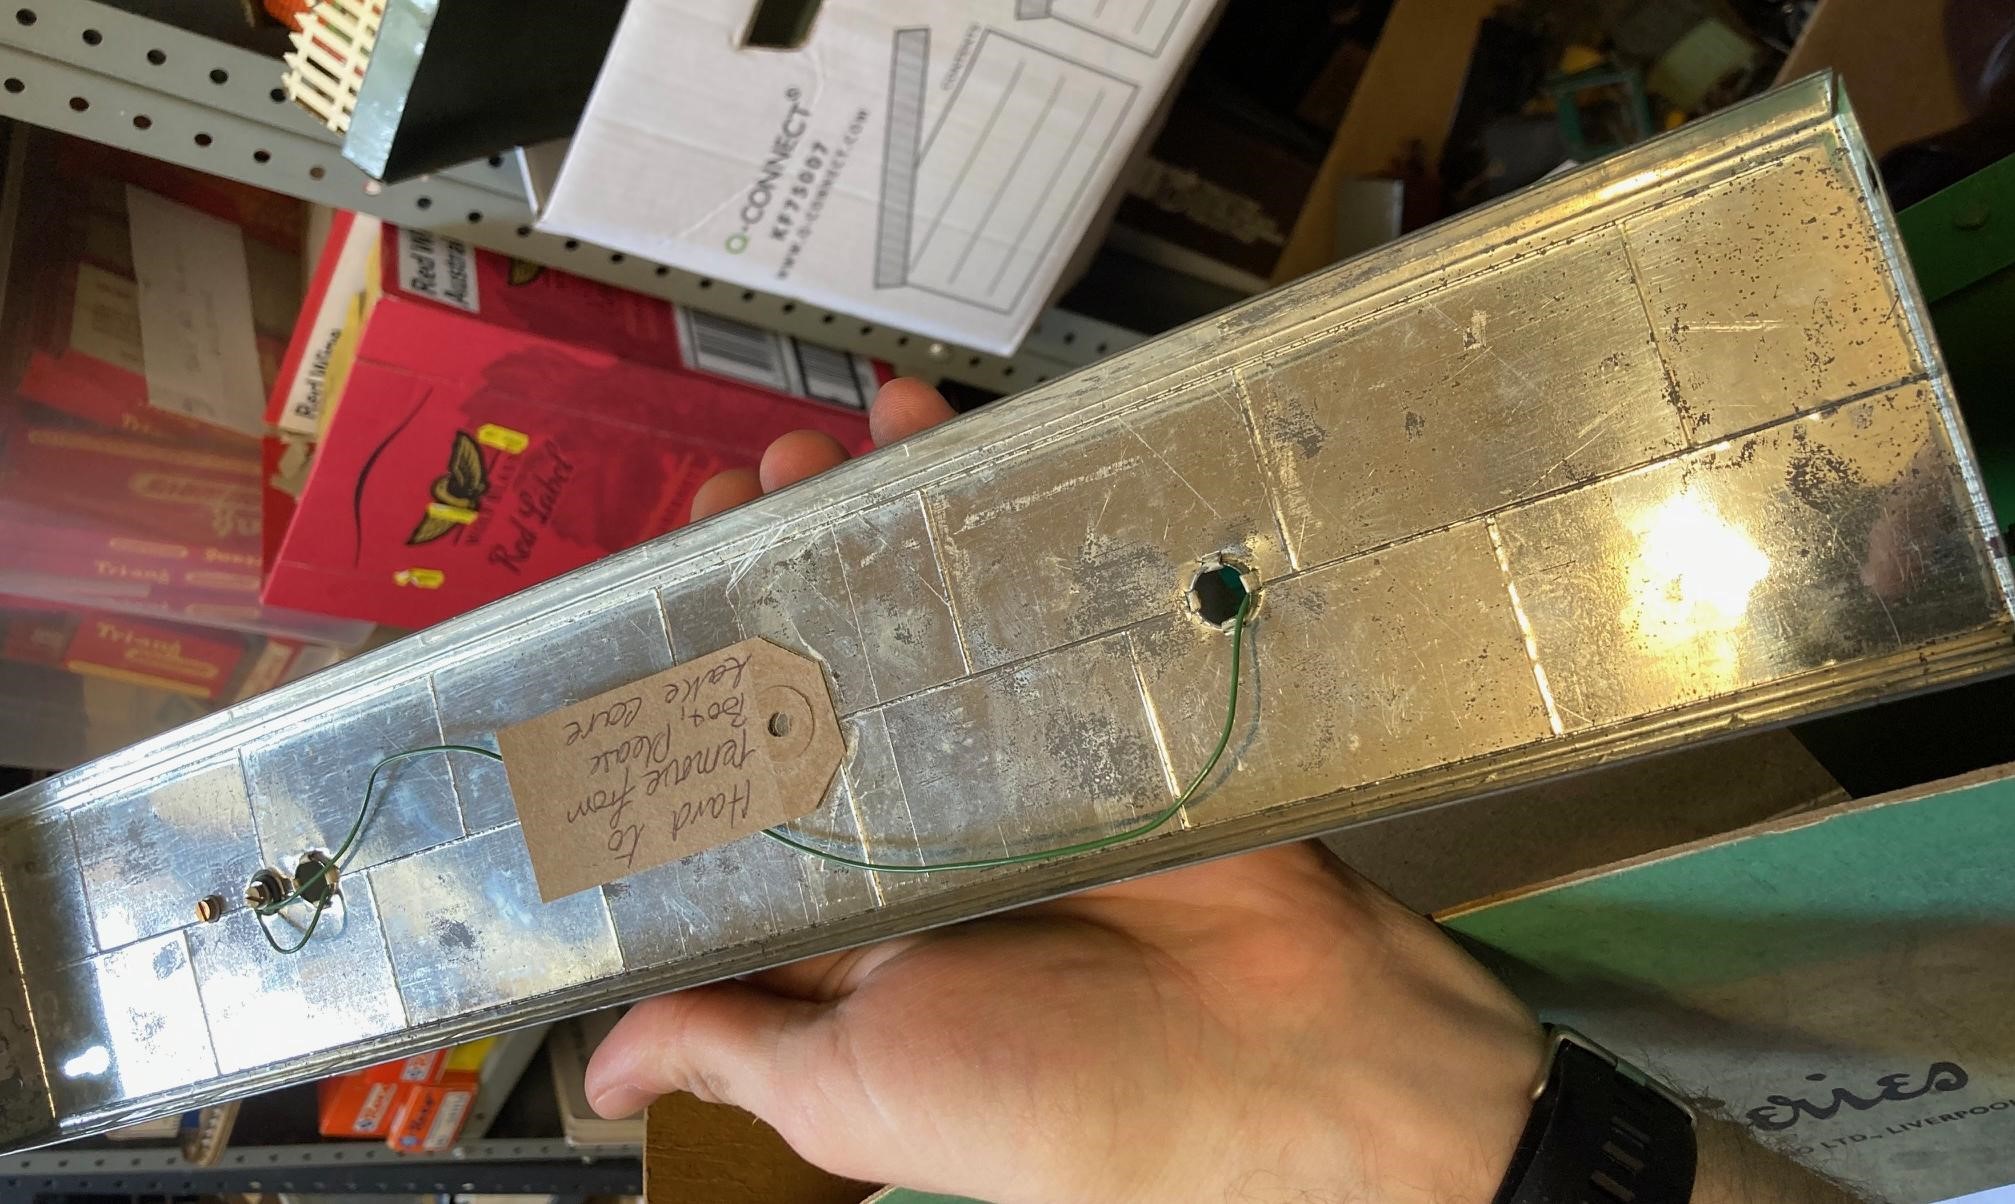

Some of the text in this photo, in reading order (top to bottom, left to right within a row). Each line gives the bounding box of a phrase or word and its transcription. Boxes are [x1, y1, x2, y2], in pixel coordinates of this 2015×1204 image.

[488, 515, 537, 575] Red
[518, 438, 574, 524] Label
[562, 653, 752, 746] take care
[567, 728, 756, 829] remove from
[608, 779, 751, 868] Hard to
[1745, 1062, 1968, 1131] eries
